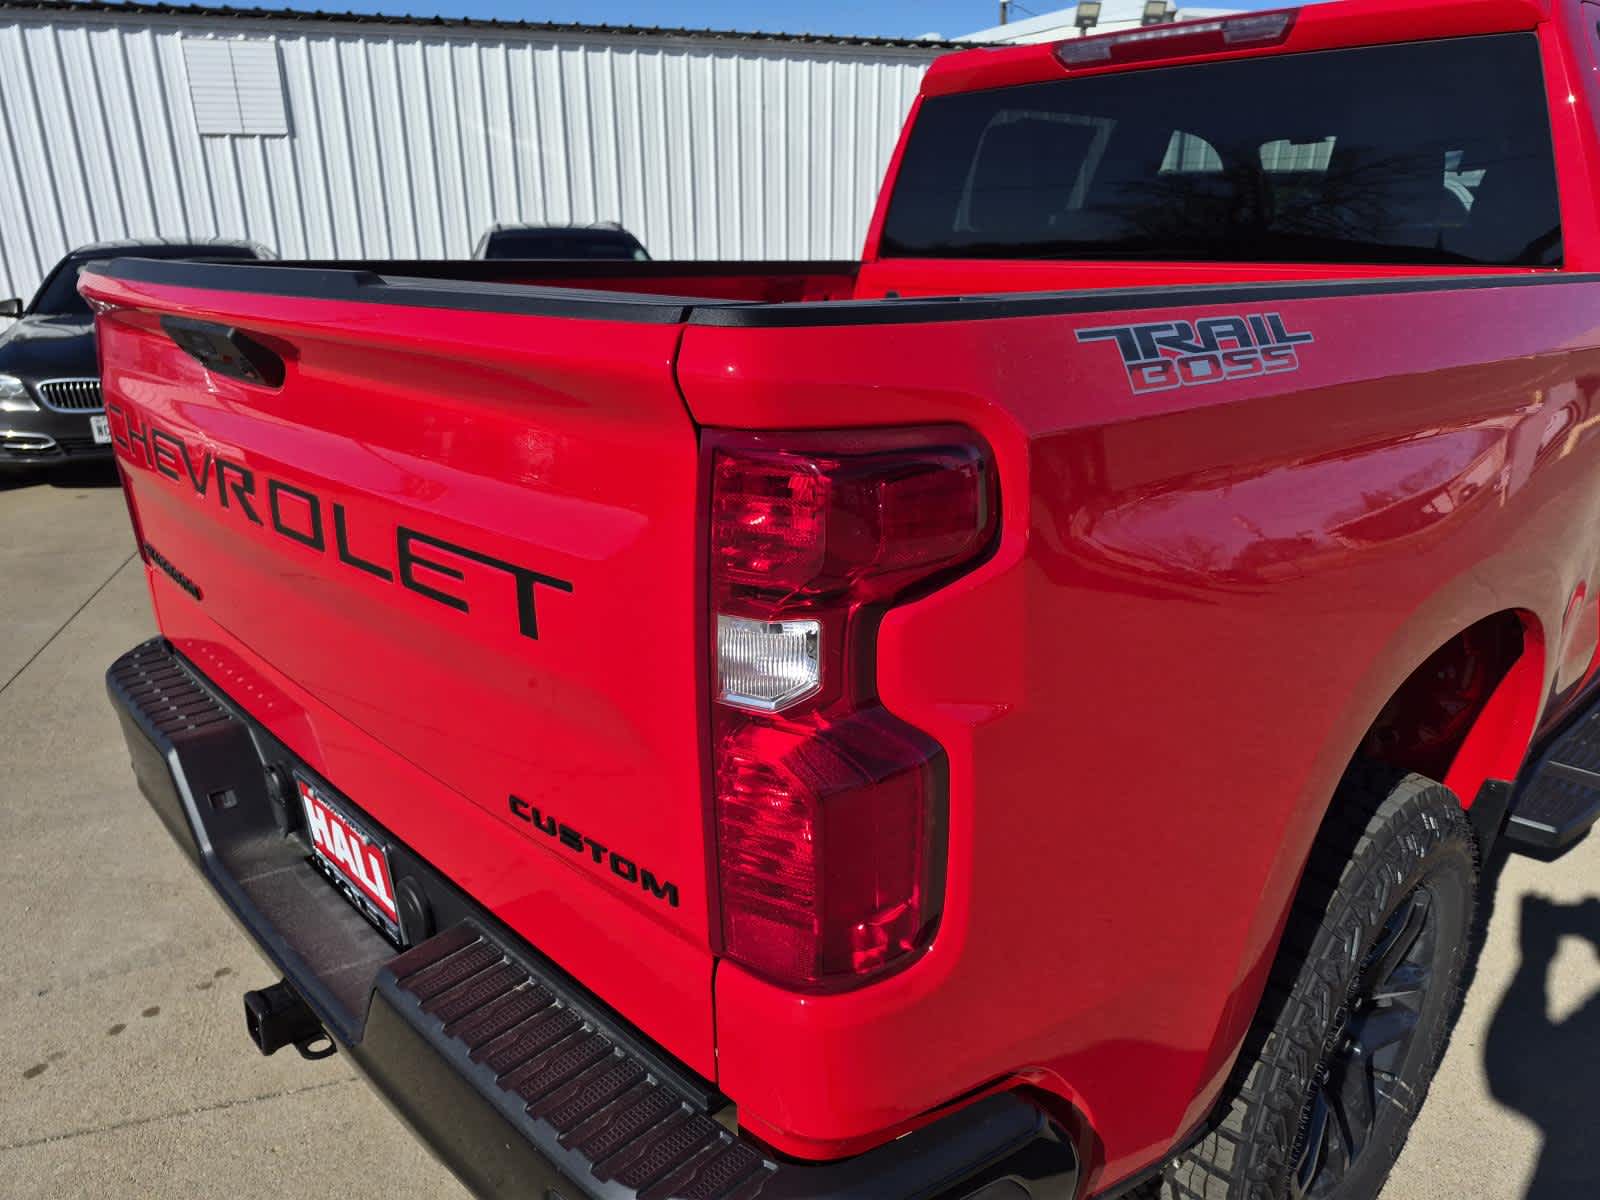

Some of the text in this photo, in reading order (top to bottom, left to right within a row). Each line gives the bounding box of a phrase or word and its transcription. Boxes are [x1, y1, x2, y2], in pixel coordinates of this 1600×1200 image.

[1073, 312, 1314, 363] TRAIL
[1126, 344, 1299, 395] BOSS
[107, 402, 574, 641] CHEVROLET
[303, 795, 397, 913] HALL
[508, 793, 680, 908] CUSTOM
